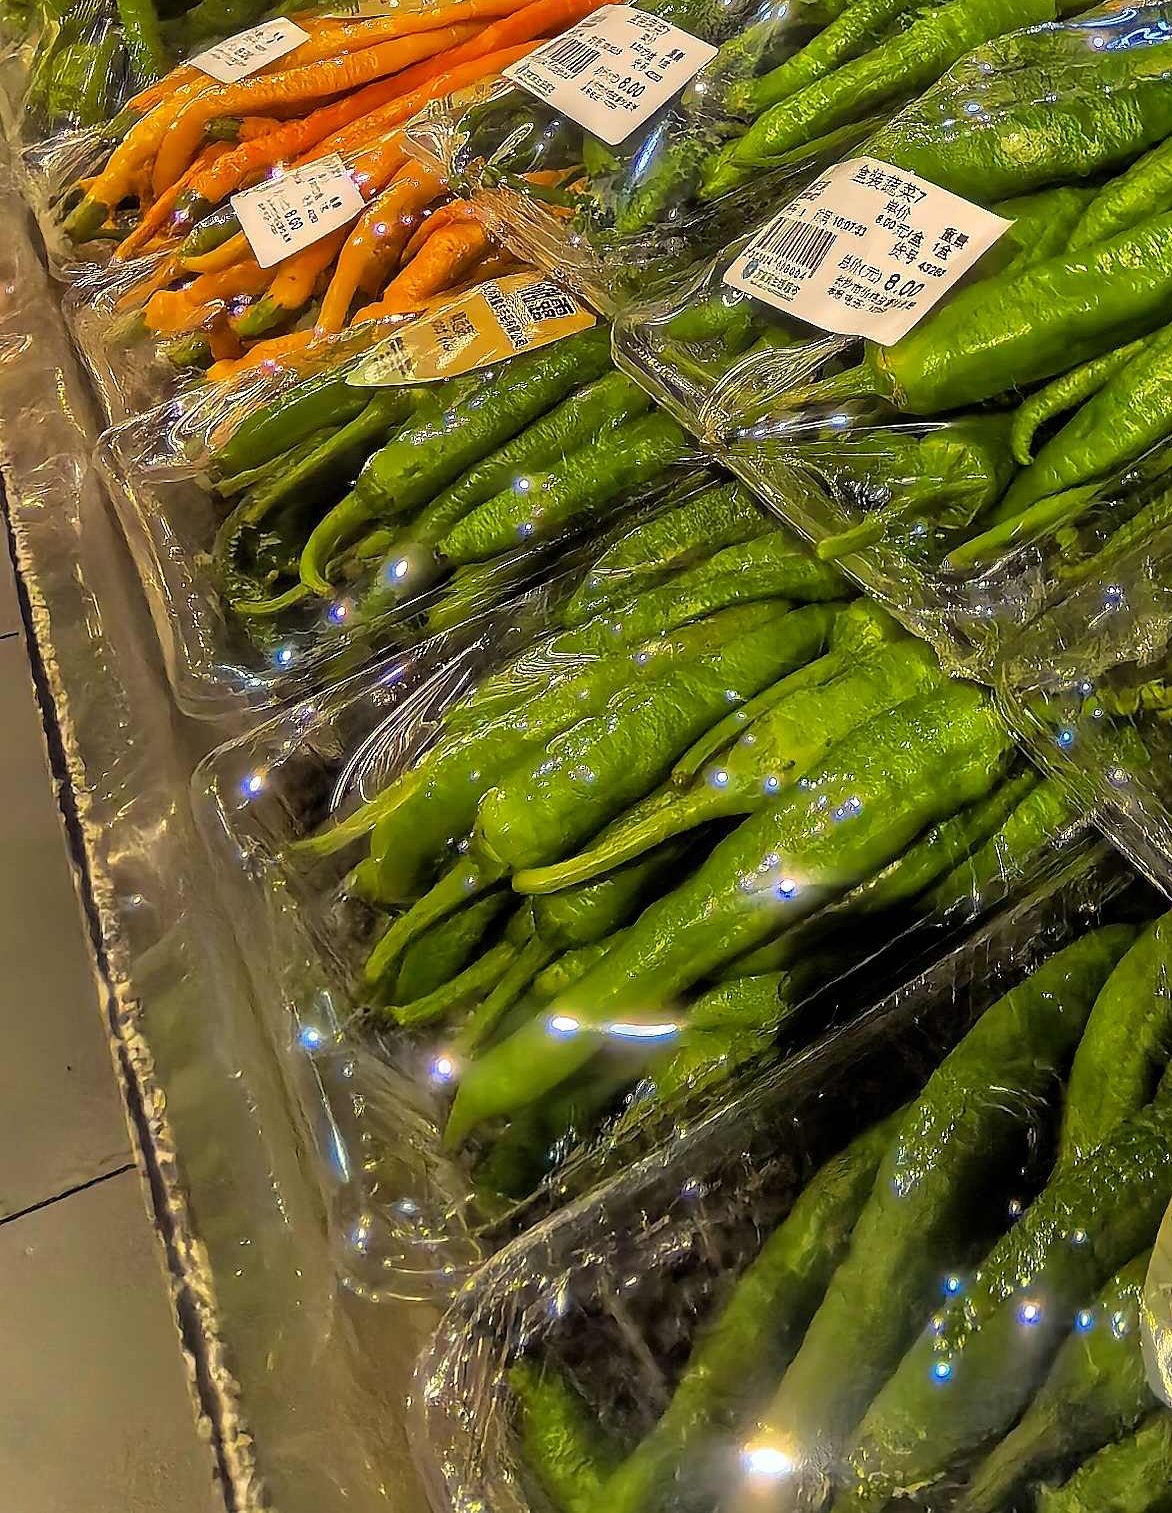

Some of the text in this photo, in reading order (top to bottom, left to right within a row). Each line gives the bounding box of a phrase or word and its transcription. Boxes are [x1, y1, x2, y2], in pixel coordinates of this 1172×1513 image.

[618, 76, 647, 98] 8.00
[850, 164, 927, 204] 盒装蔬菜7
[884, 272, 926, 300] 8.00
